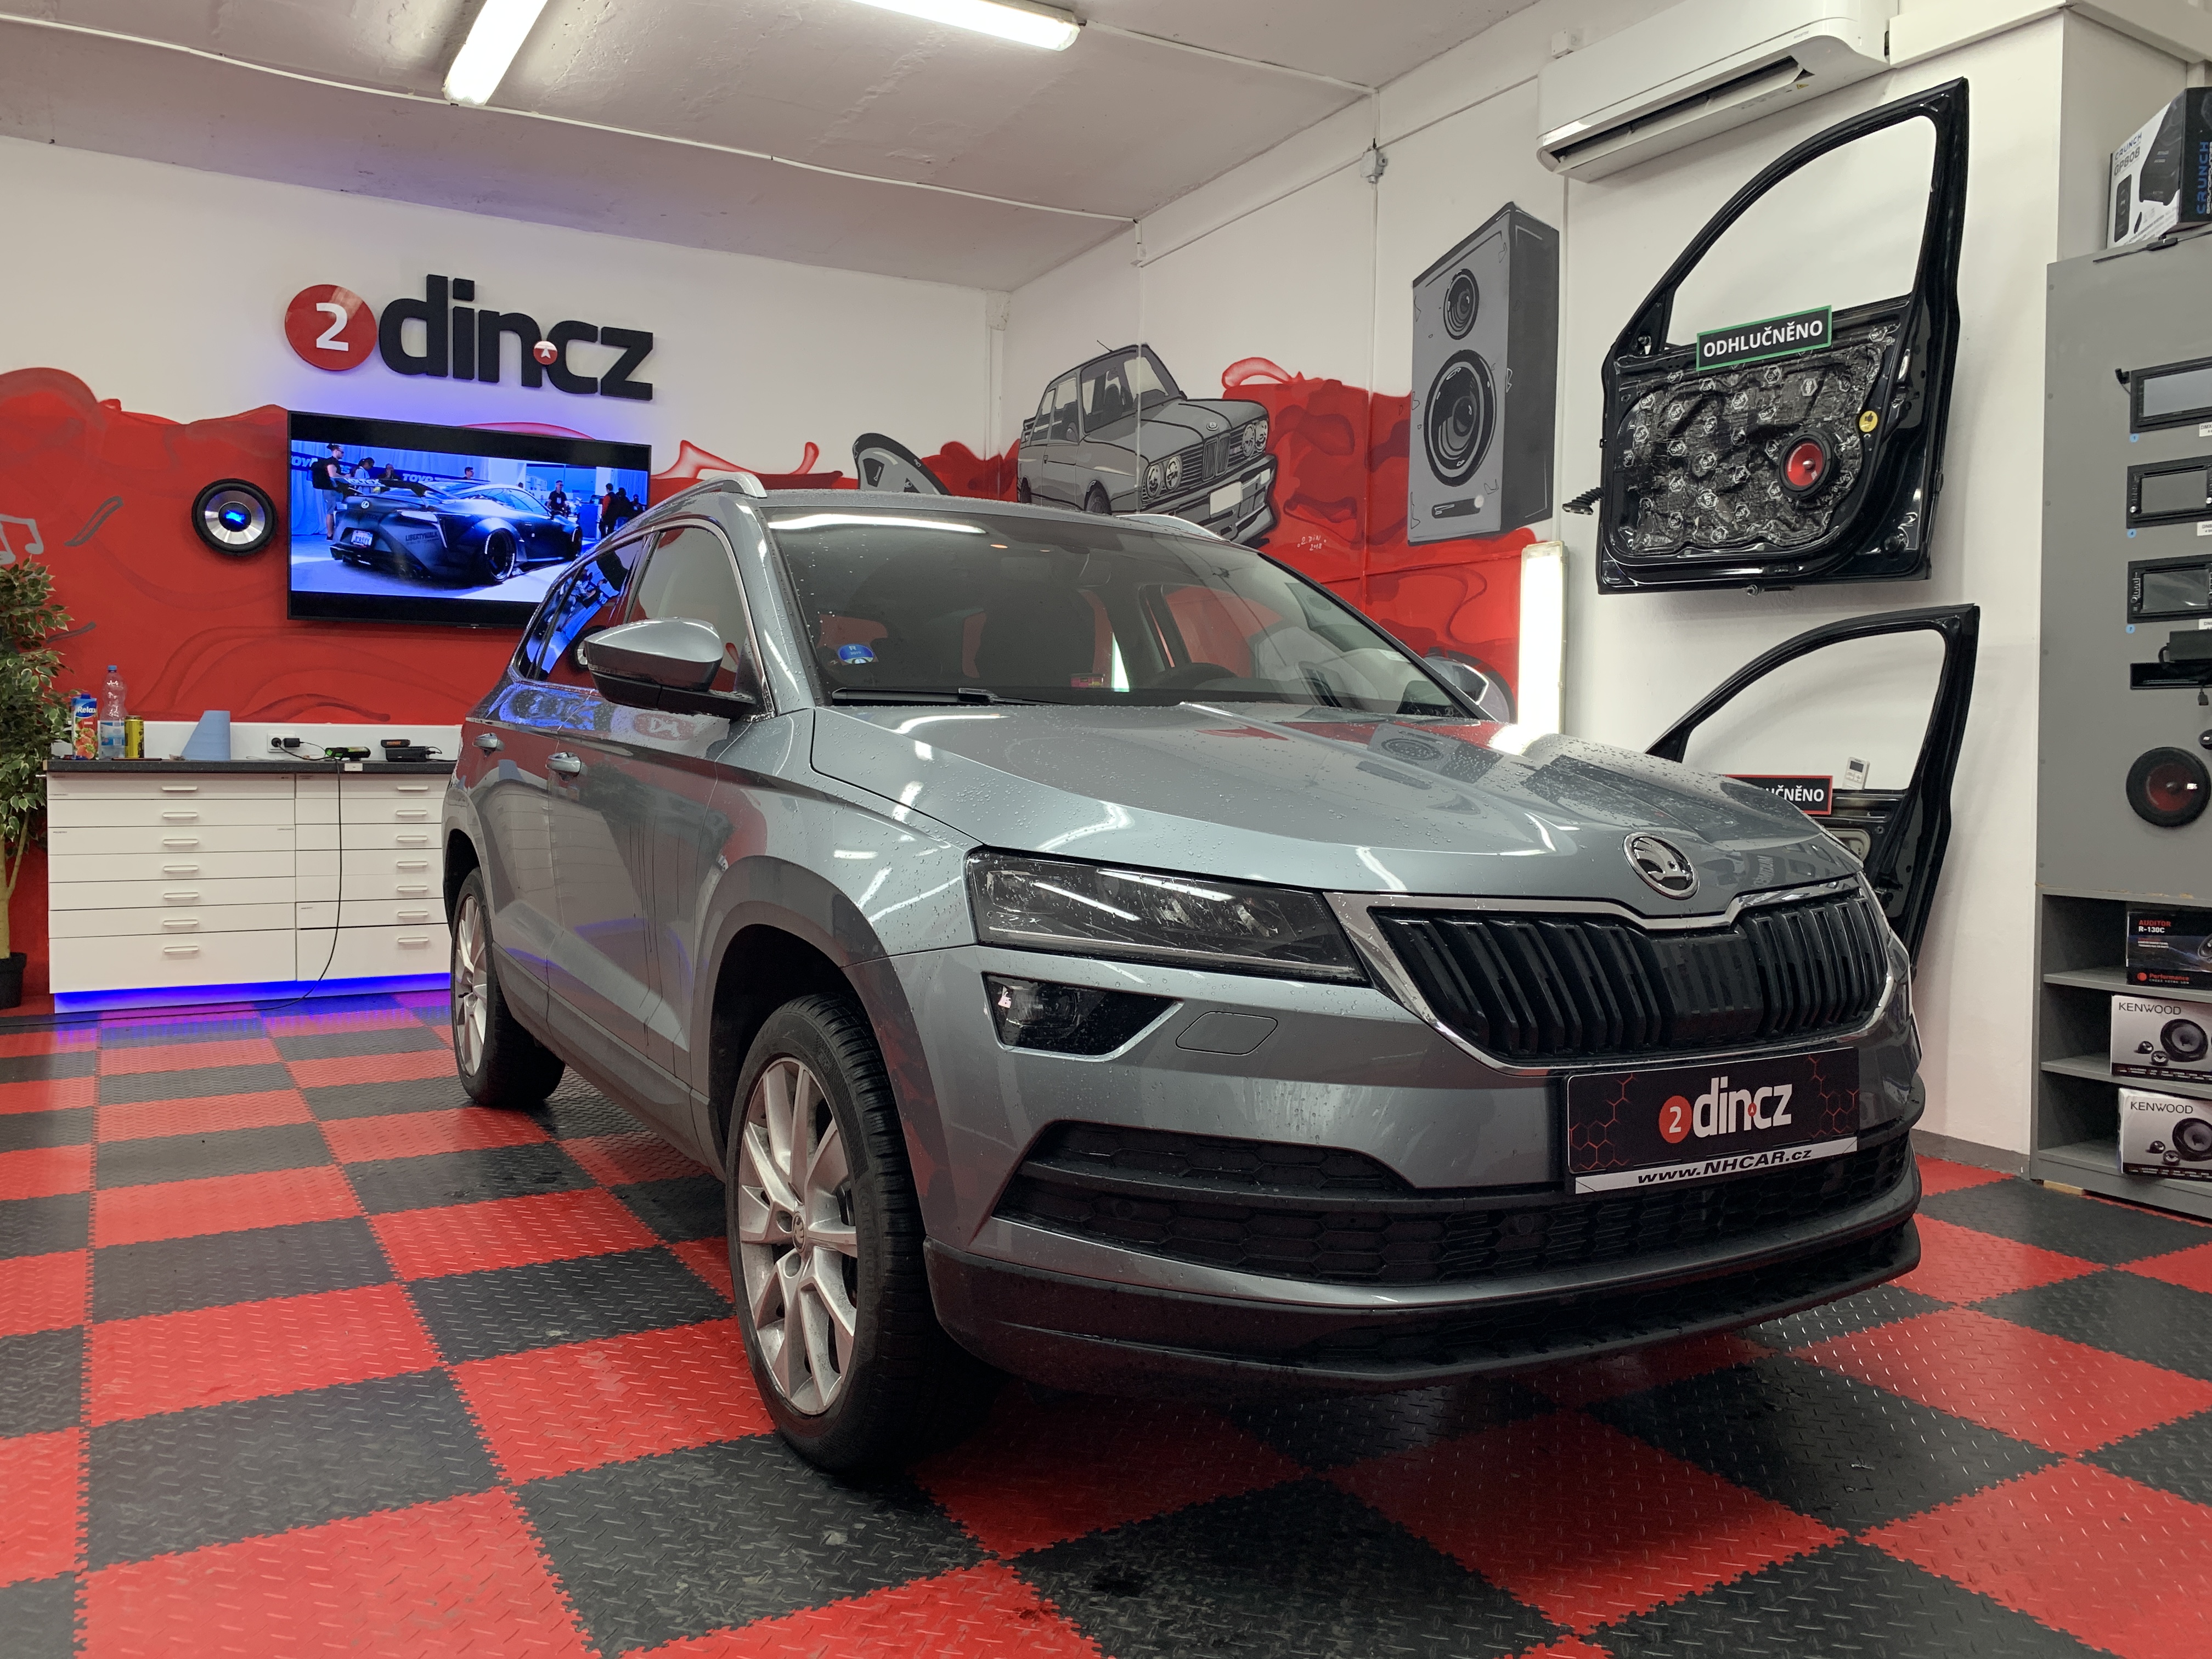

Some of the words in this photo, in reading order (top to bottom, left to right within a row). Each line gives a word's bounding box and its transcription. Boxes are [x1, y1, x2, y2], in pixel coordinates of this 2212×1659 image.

[2114, 146, 2141, 176] GP808
[2196, 141, 2209, 215] CRUNCH
[1703, 319, 1823, 358] ODHLUČNĚNO
[2118, 1001, 2182, 1015] KENWOOD
[2130, 1101, 2194, 1114] KENWOOD
[1637, 1148, 1813, 1184] www.NHCAR.cz
